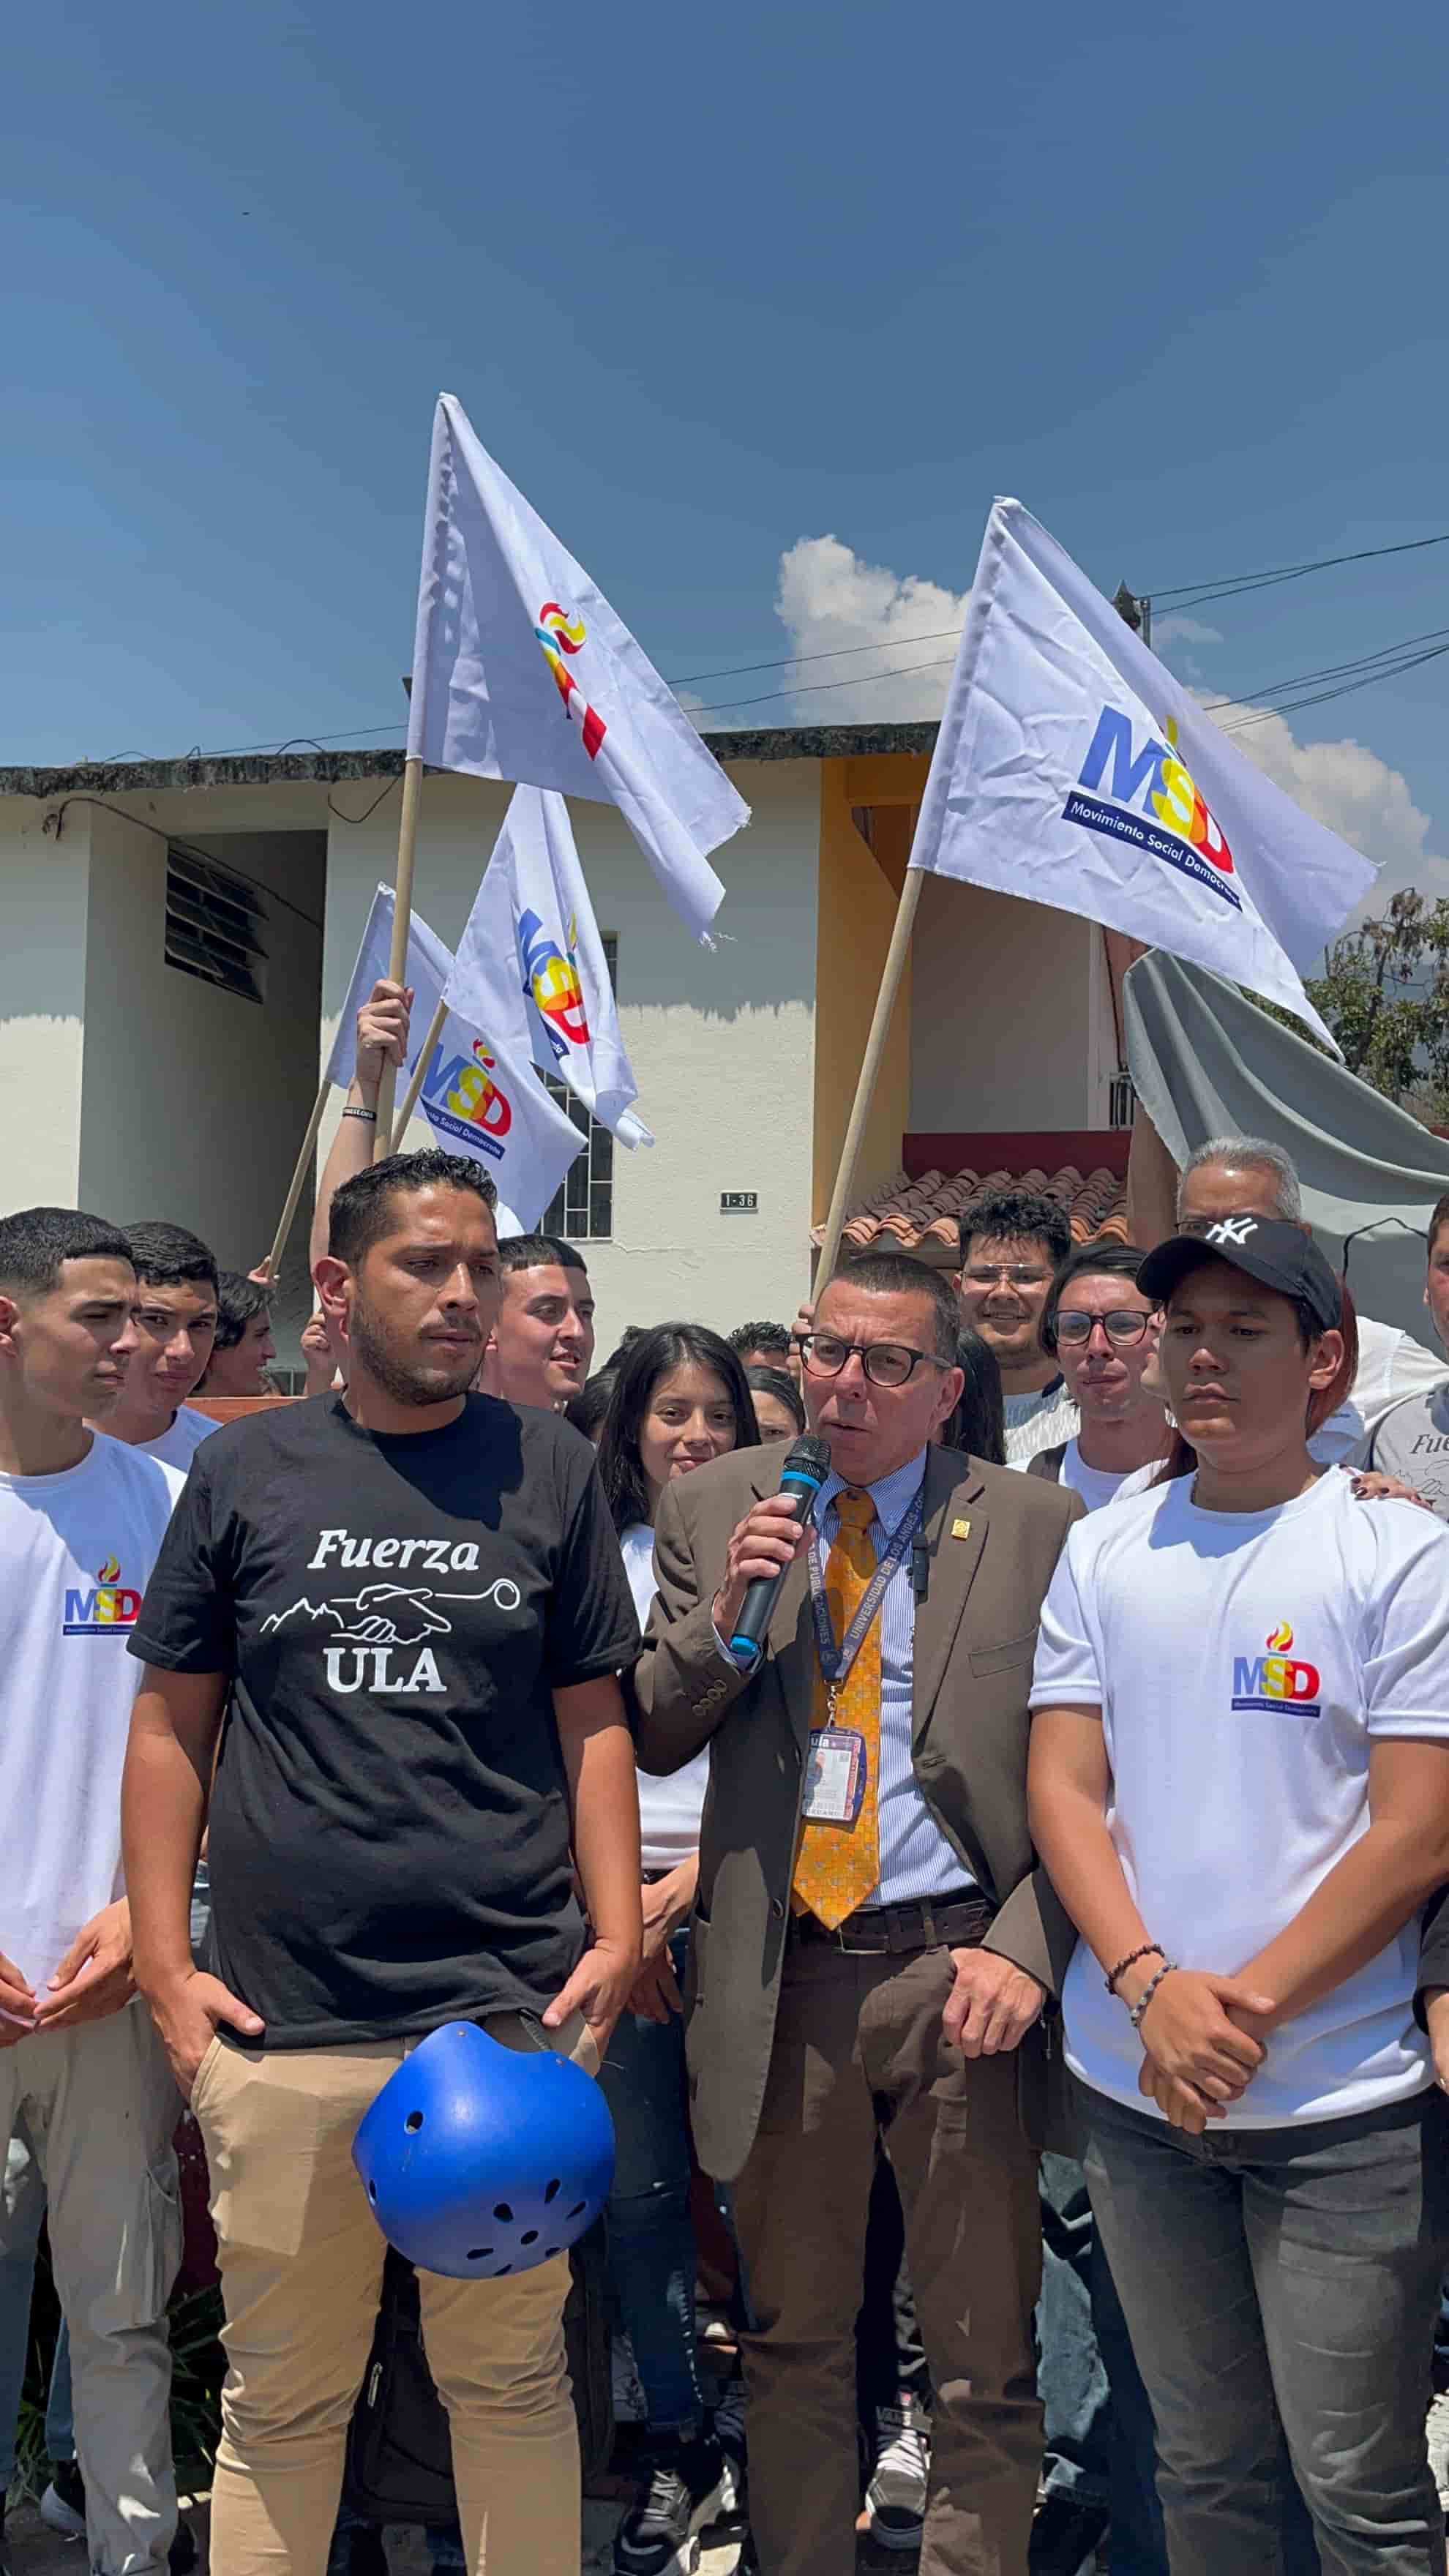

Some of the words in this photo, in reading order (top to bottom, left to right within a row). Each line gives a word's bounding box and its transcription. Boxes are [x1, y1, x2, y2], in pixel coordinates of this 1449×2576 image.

[1071, 801, 1144, 840] Movimiento
[1147, 834, 1184, 861] Social
[726, 1194, 753, 1207] 1-36
[307, 1529, 480, 1573] Fuerza
[850, 1576, 886, 1639] UNIVERSIDAD
[880, 1561, 894, 1576] DE
[890, 1540, 903, 1562] LOS
[900, 1512, 918, 1541] ANDES
[64, 1589, 142, 1624] MSD
[323, 1647, 448, 1693] ULA
[1233, 1657, 1320, 1701] MSD
